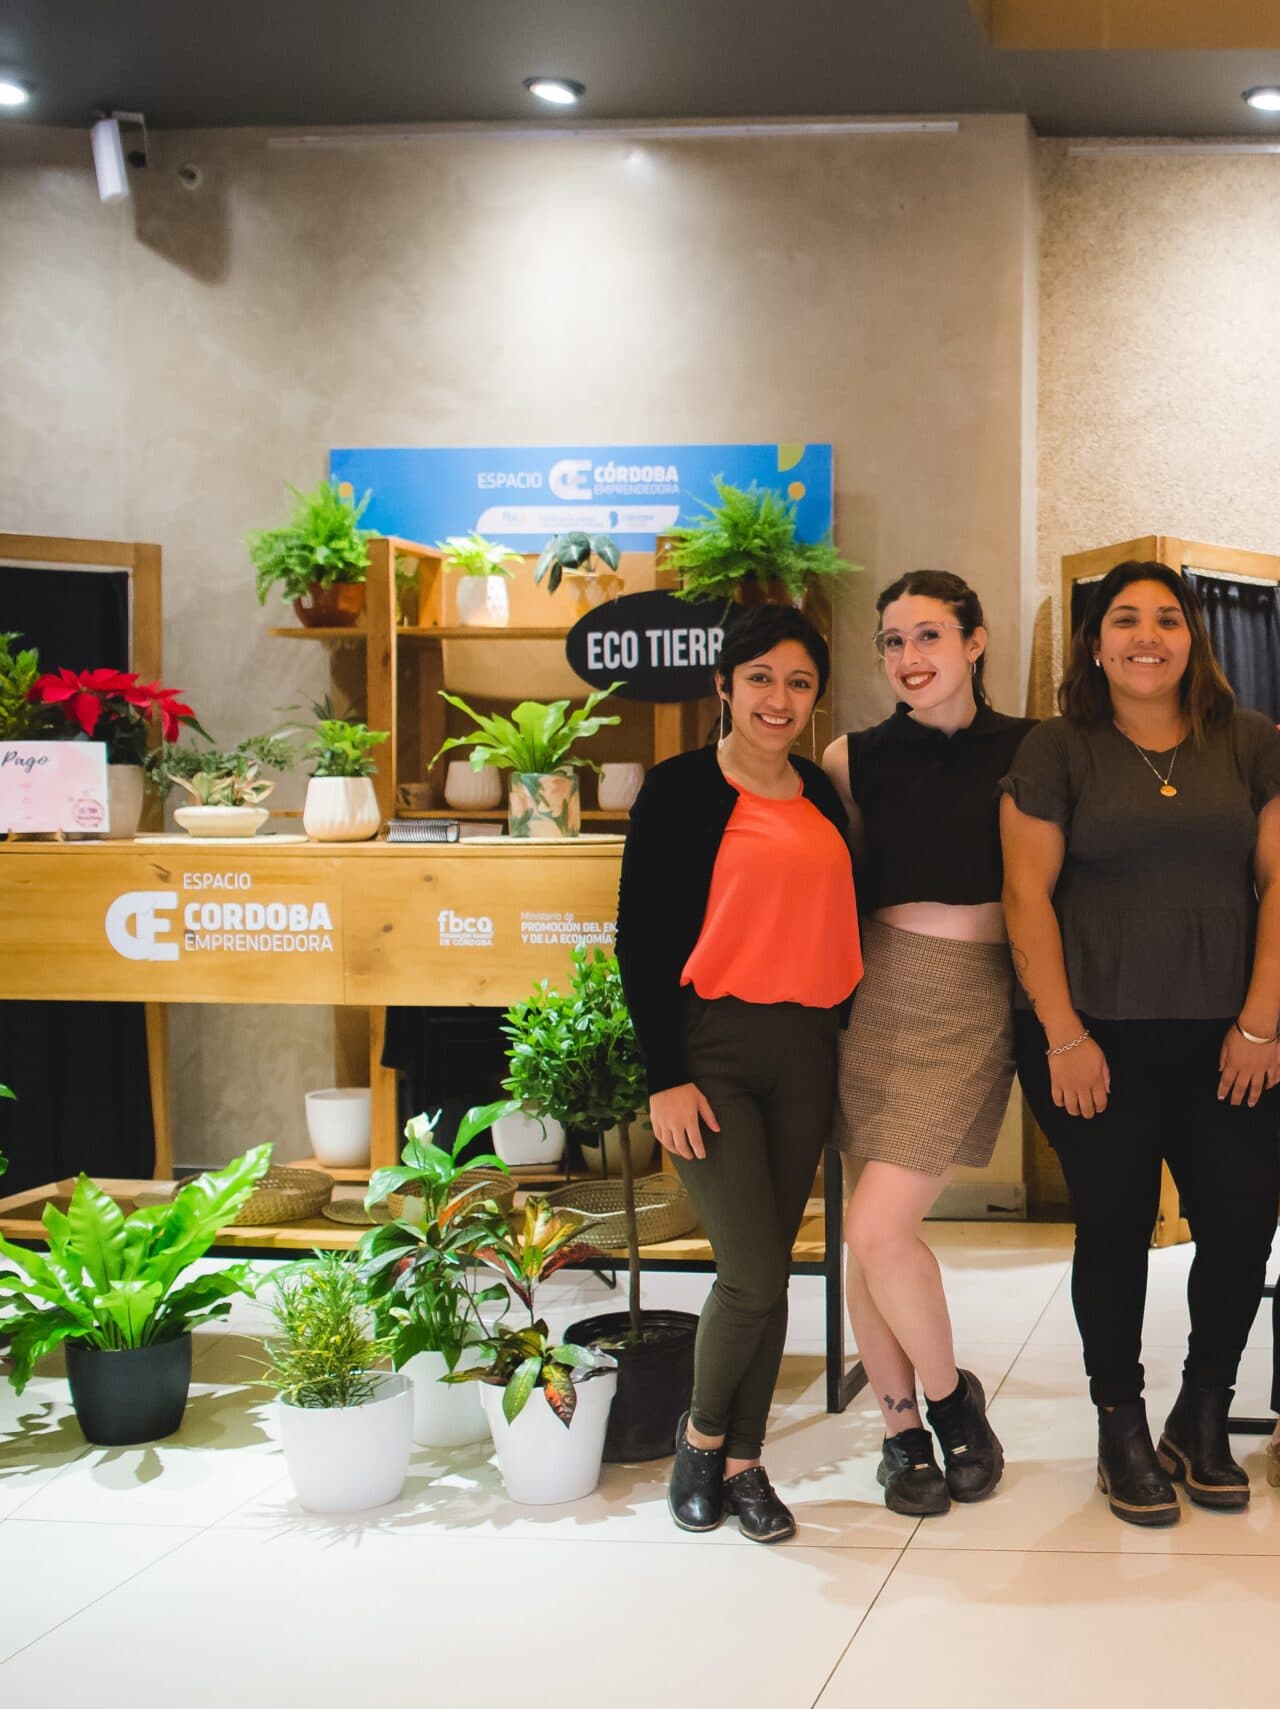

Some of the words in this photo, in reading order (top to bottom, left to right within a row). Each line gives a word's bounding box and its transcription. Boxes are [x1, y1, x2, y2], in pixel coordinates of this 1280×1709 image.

[477, 472, 543, 489] ESPACIO
[594, 461, 679, 483] CÓRDOBA
[586, 630, 639, 670] ECO
[645, 627, 725, 667] TIERR
[1, 750, 48, 773] Pago
[183, 872, 252, 890] ESPACIO
[184, 902, 334, 931] CORDOBA
[520, 920, 580, 933] PROMOCIÓN
[582, 922, 601, 932] DEL
[184, 933, 334, 952] EMPRENDEDORA
[520, 933, 529, 944] Y
[530, 933, 543, 944] DE
[544, 933, 558, 944] LA
